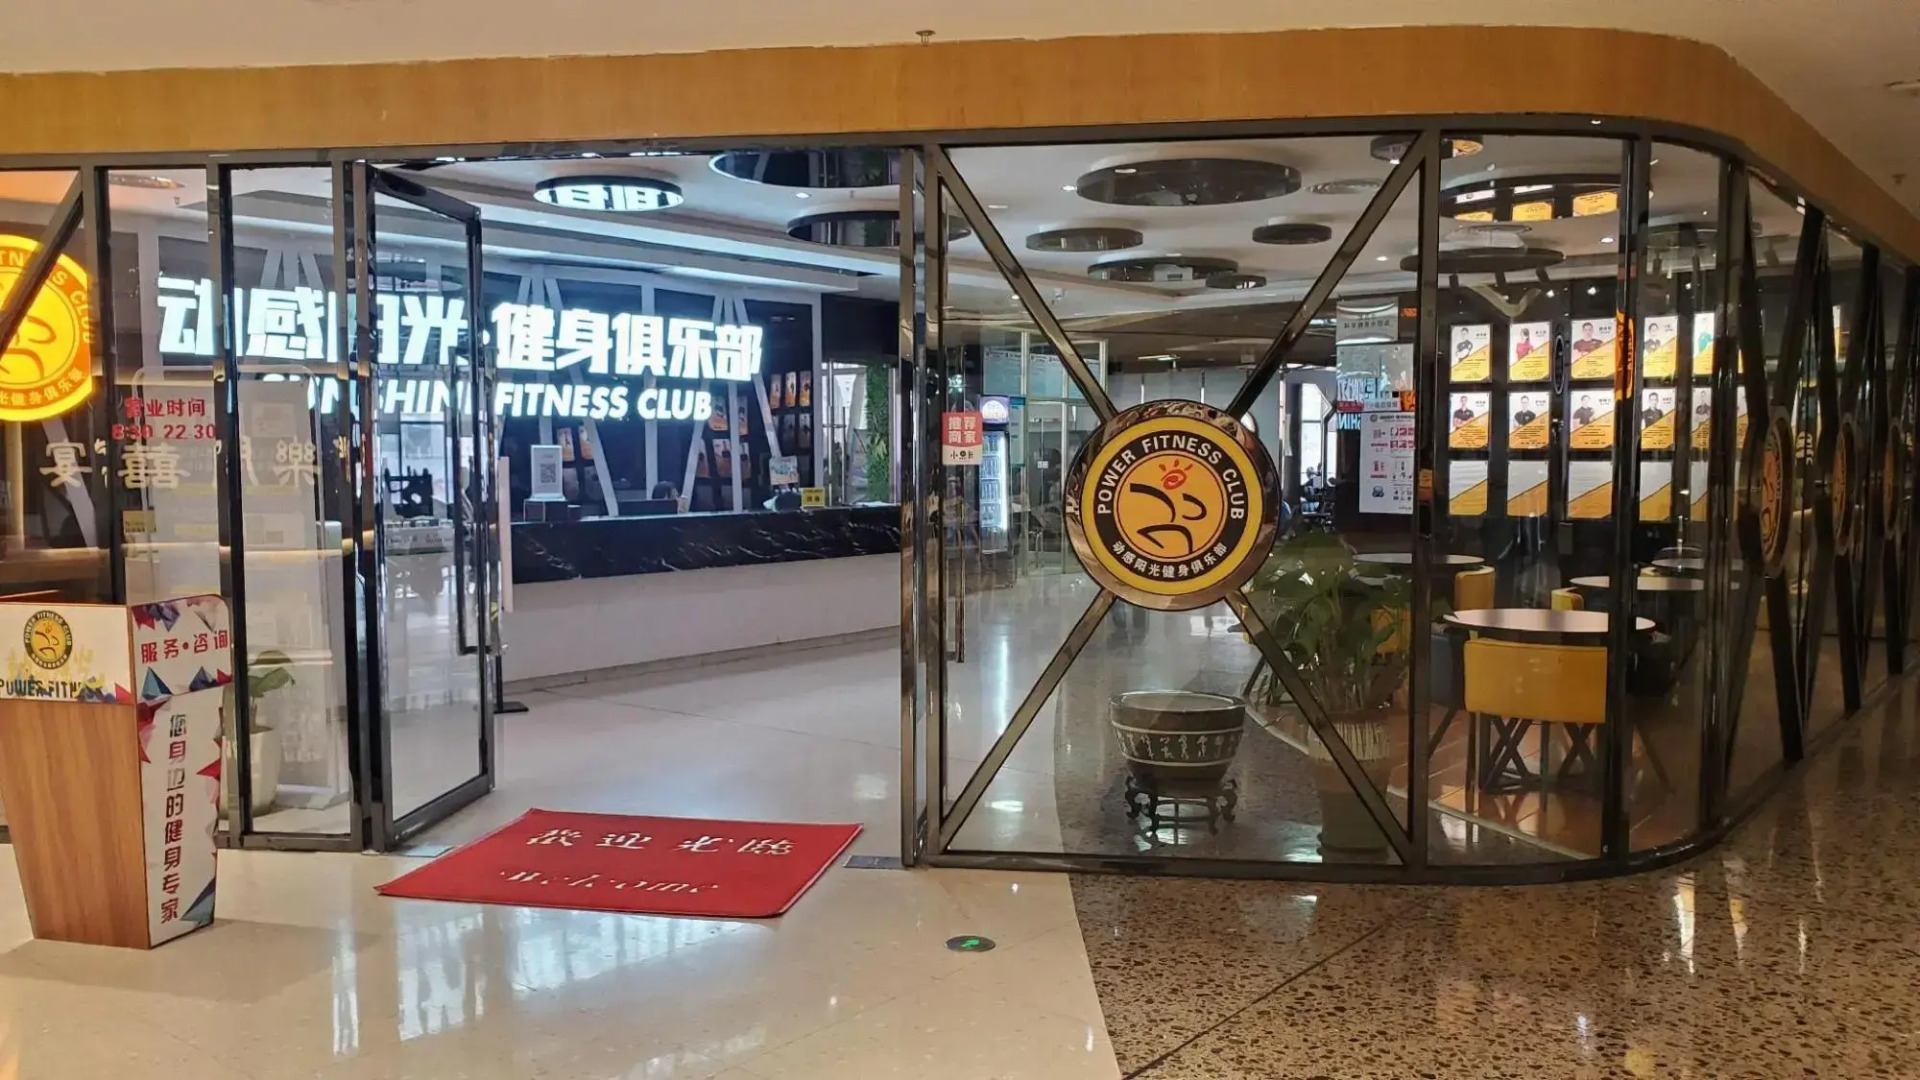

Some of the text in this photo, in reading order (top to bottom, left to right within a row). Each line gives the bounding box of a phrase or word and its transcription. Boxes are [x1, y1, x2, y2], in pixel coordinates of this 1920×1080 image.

[125, 397, 206, 418] 营业时间
[496, 382, 629, 420] FITNESS
[637, 387, 713, 422] CLUB
[1097, 434, 1246, 520] POWER FITNESS CLUB
[1111, 540, 1228, 578] 动感阳光健身俱乐部
